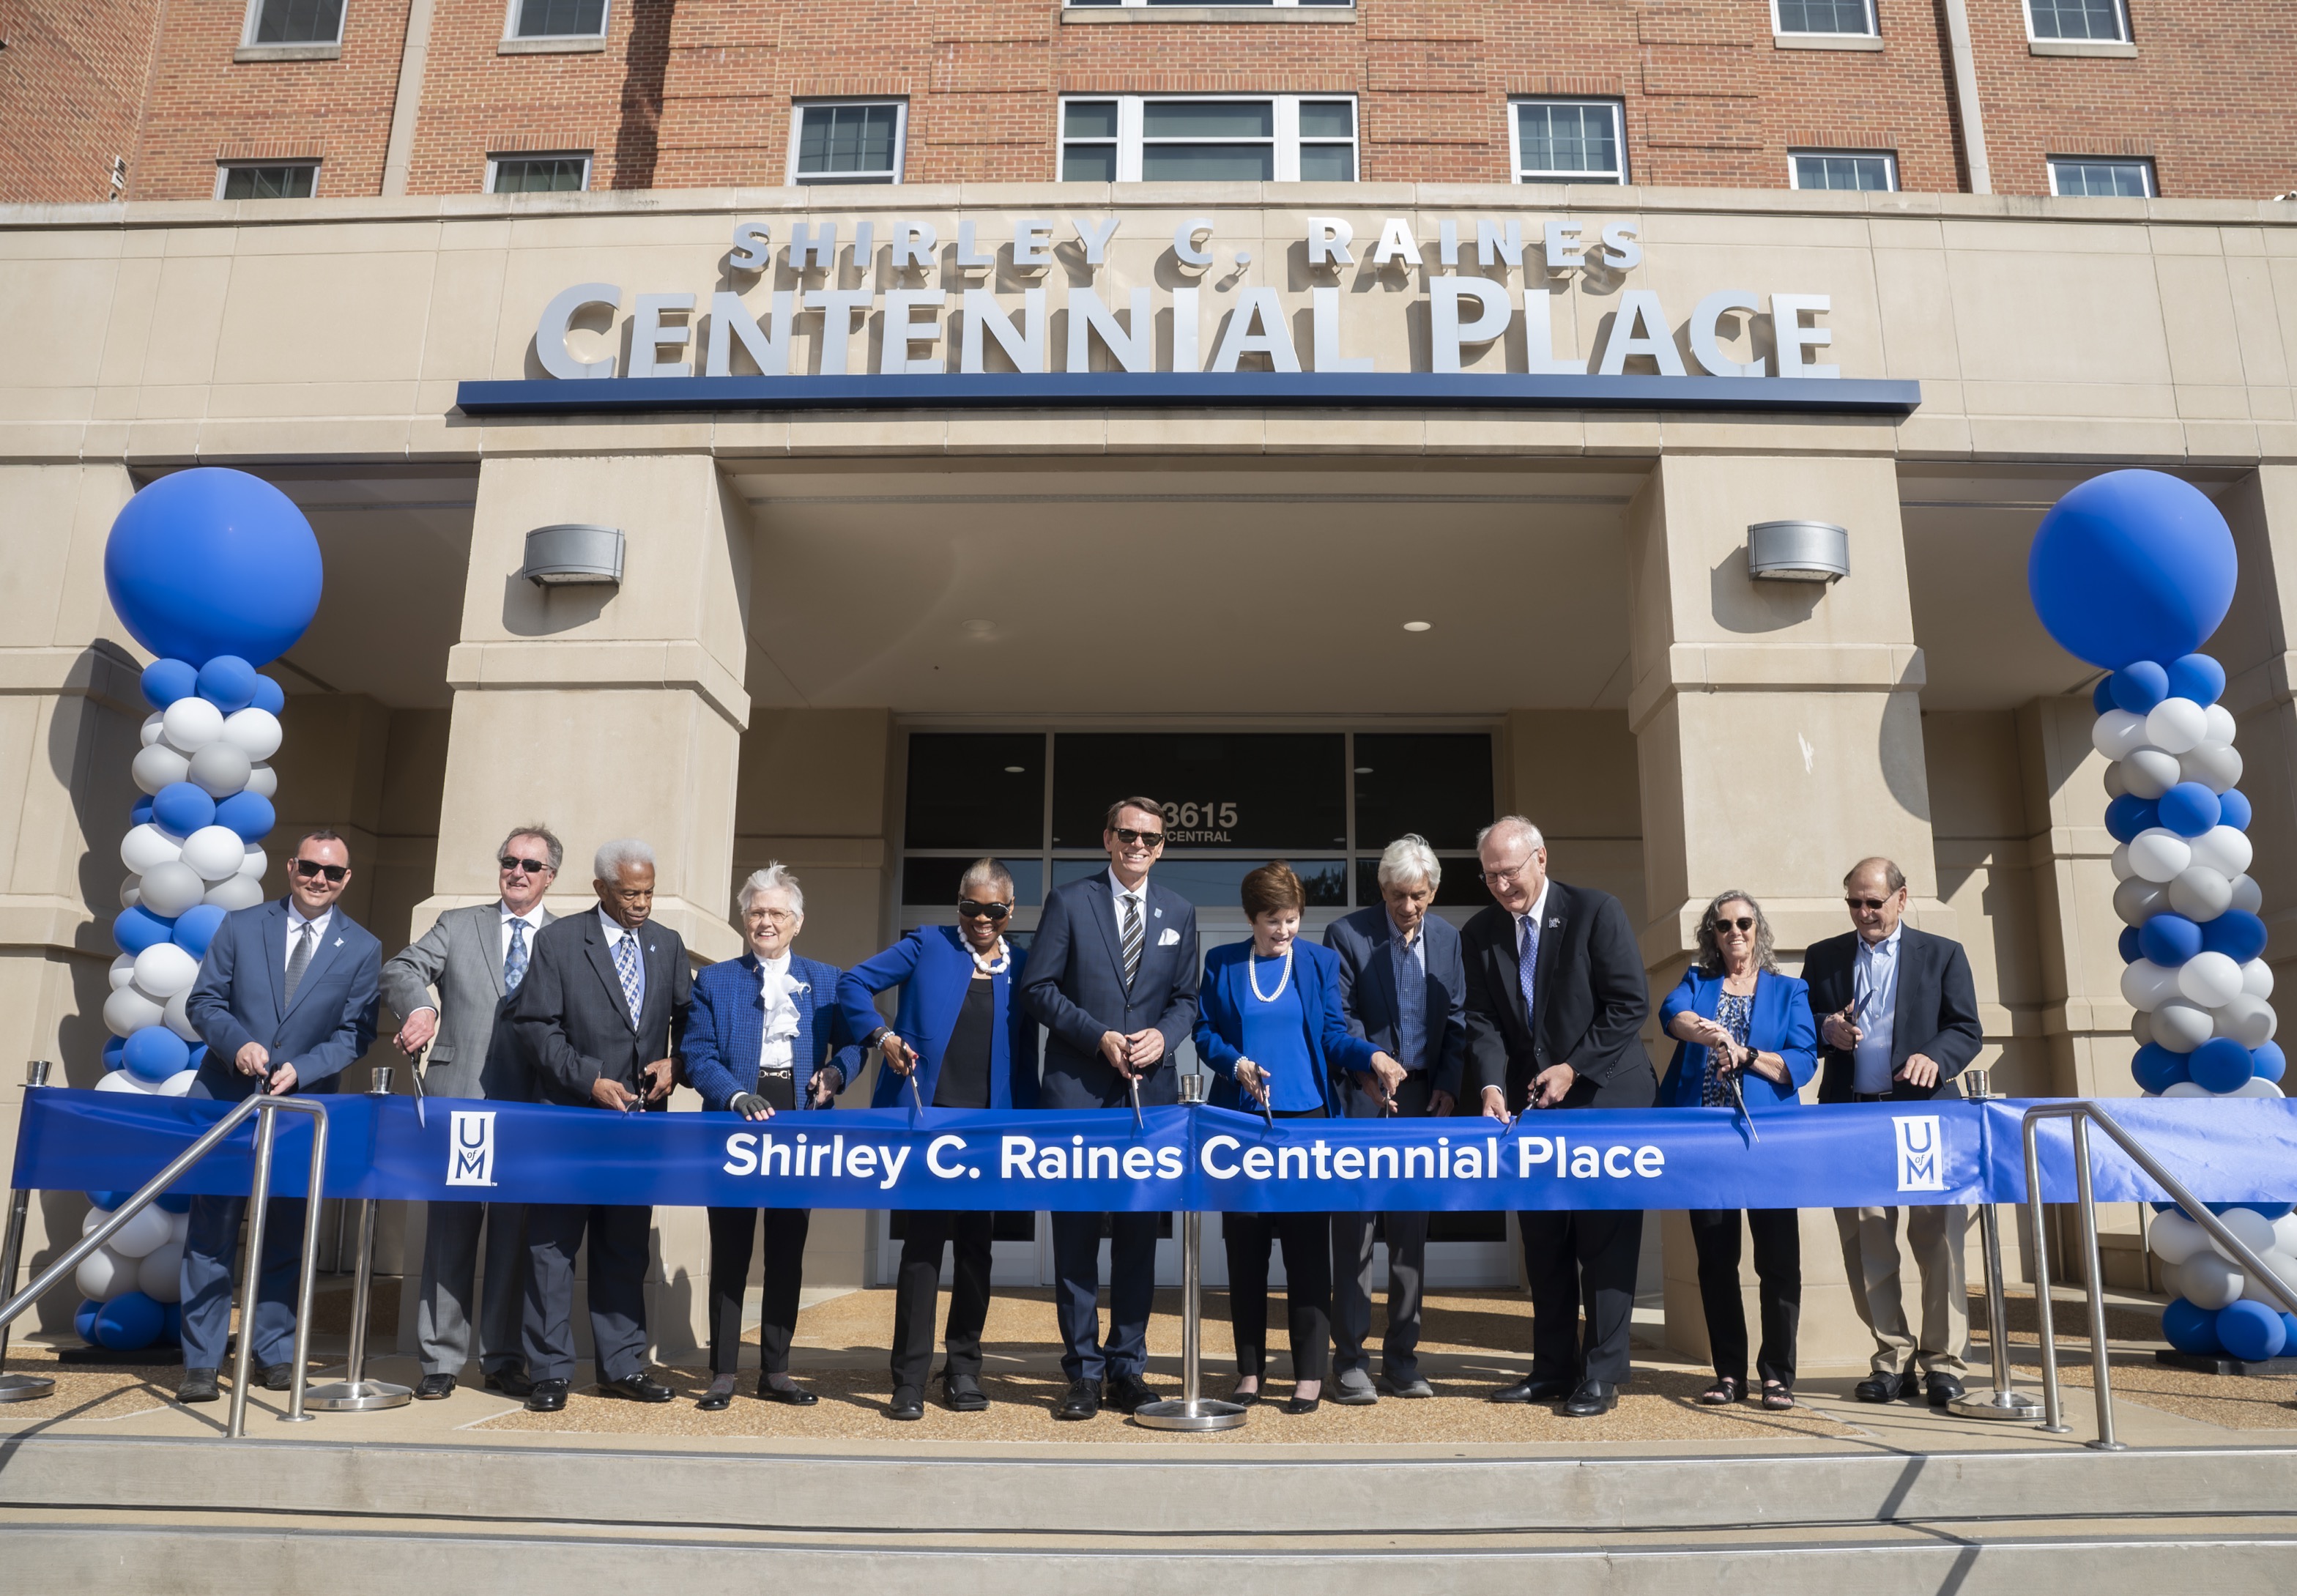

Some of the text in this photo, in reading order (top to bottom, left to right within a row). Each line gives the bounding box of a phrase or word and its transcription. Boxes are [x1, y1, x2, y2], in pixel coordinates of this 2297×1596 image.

[730, 218, 1642, 273] SHIRLEY C. RAINES
[535, 276, 1840, 379] CENTENNIAL PLACE
[1162, 801, 1238, 828] 3615
[1167, 831, 1231, 842] CENTRAL
[723, 1132, 1665, 1189] Shirley C. Raines Centennial Place
